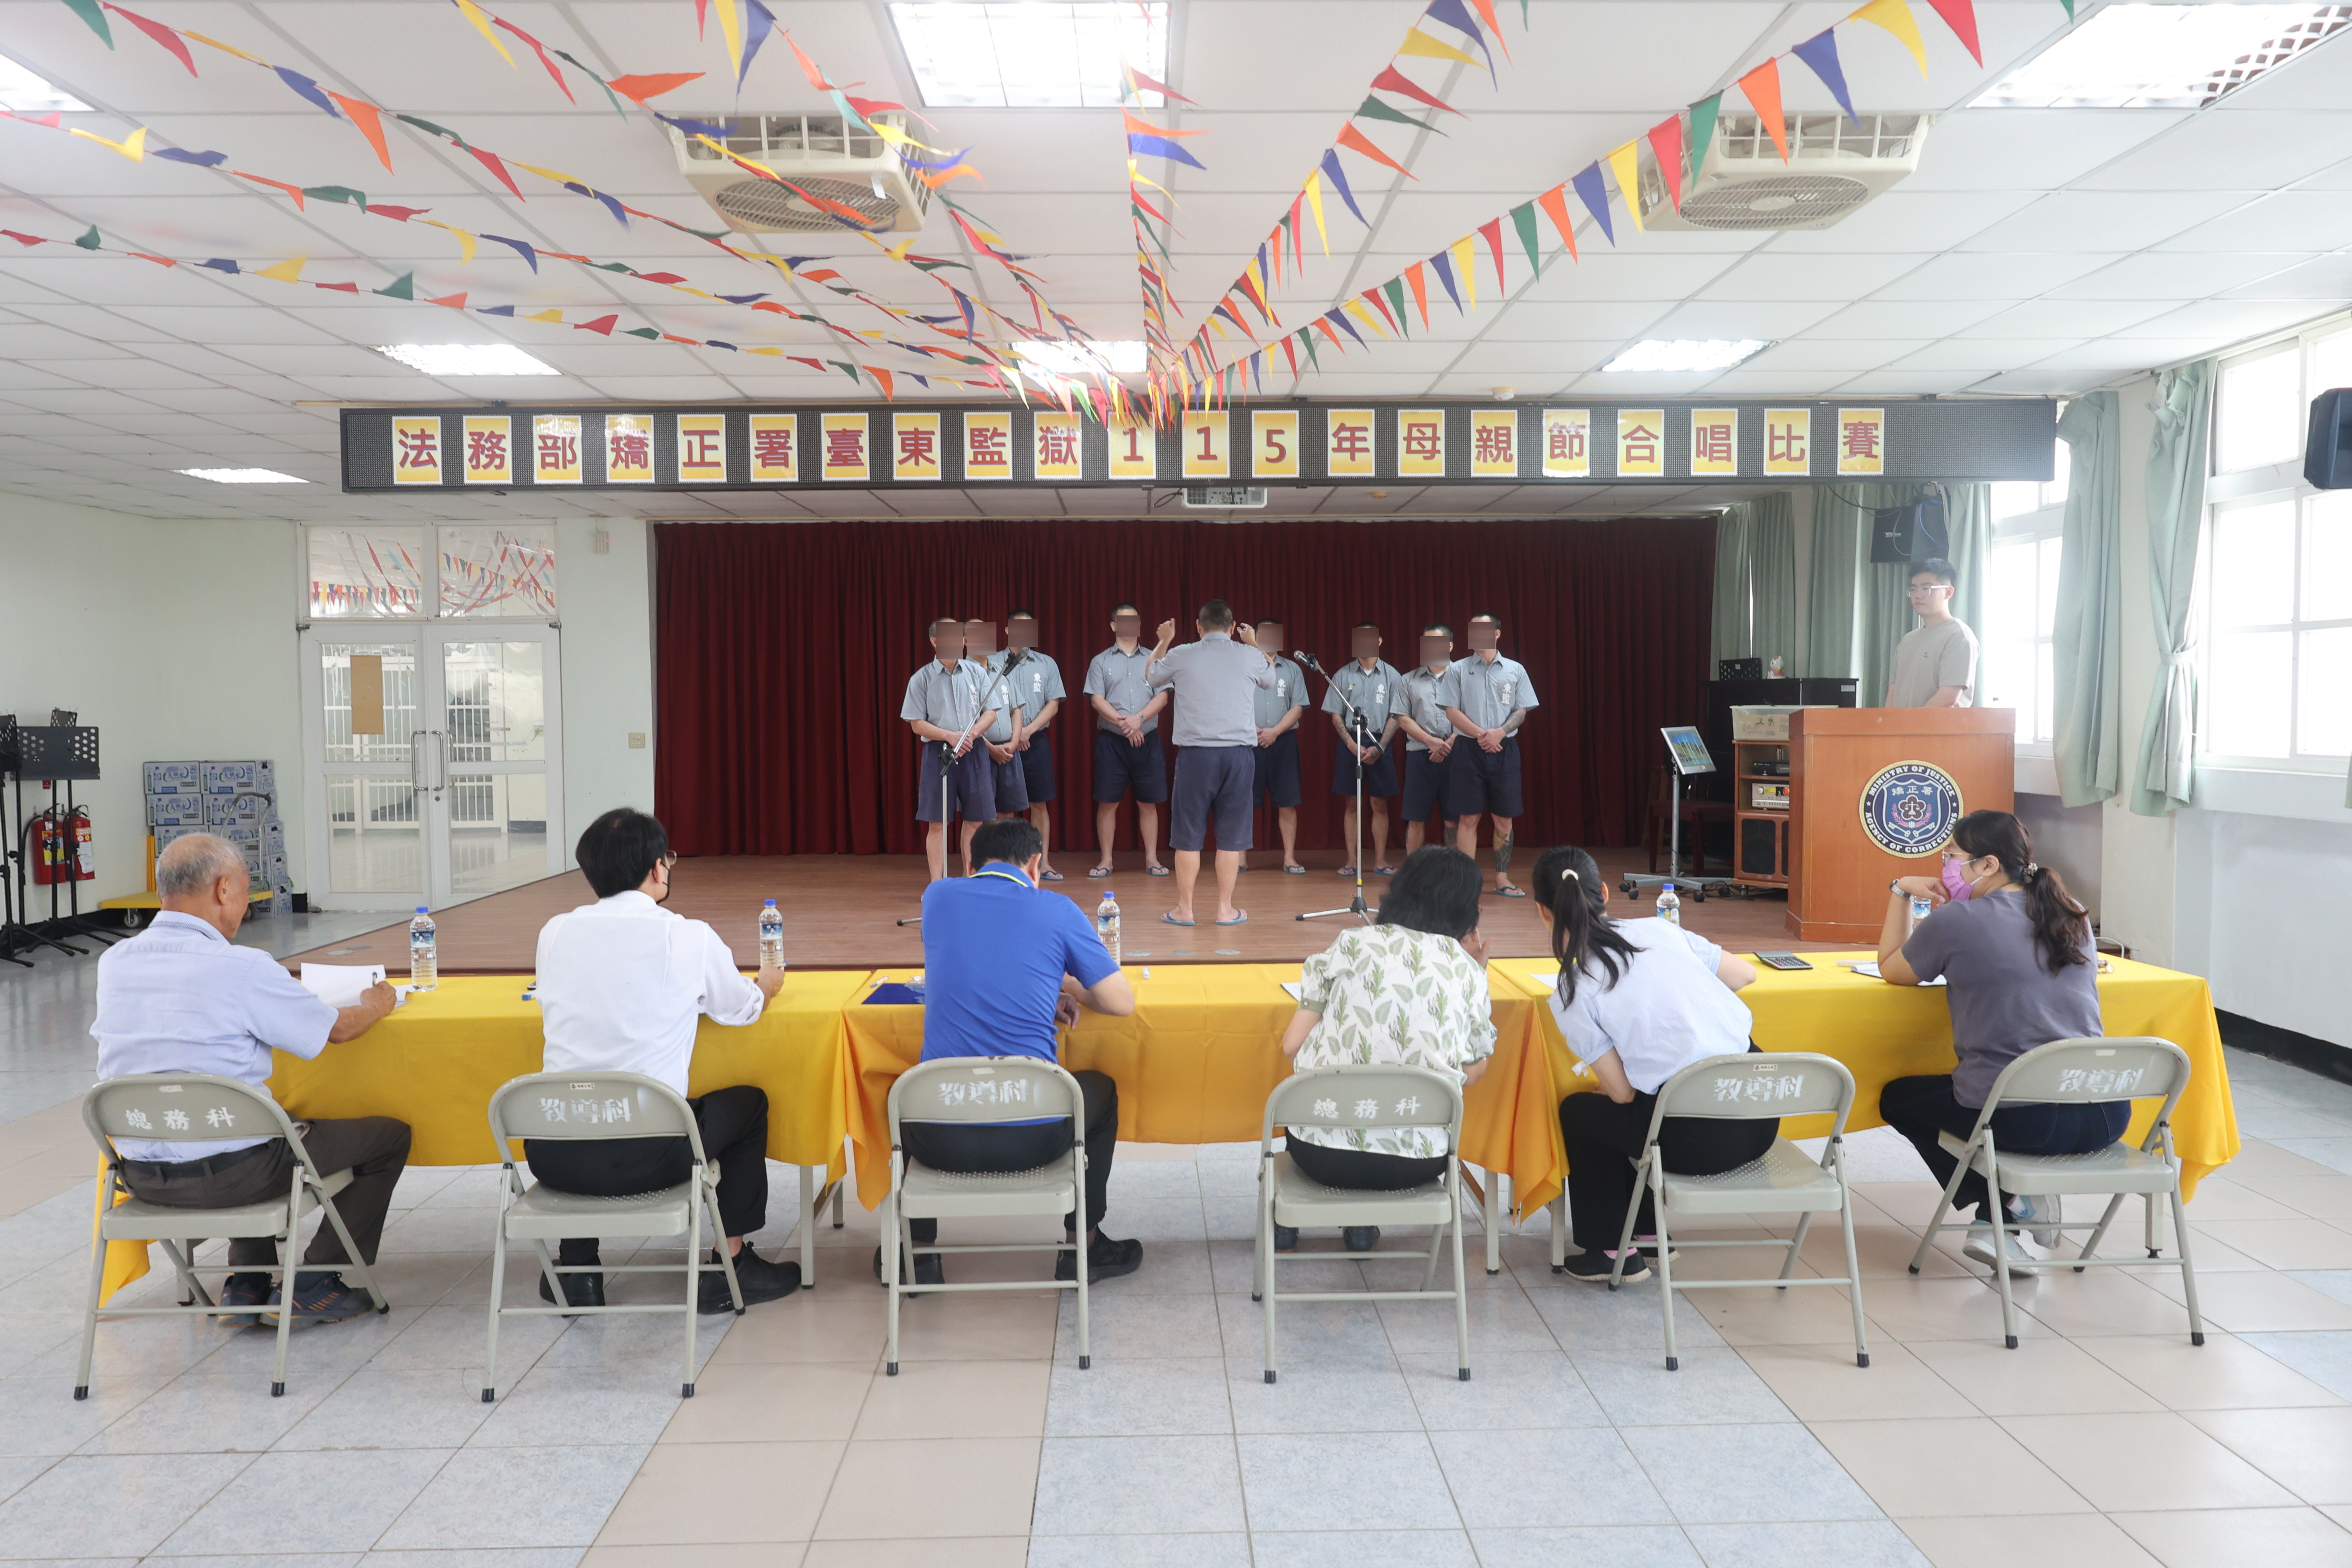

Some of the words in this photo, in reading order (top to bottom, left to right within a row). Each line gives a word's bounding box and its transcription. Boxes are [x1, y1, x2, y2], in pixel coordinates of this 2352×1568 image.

[398, 421, 1880, 470] 法務部矯正署臺東監獄115年母親節合唱比賽
[1869, 766, 1909, 797] MINISTRY
[1926, 767, 1955, 797] JUSTICE
[1891, 785, 1933, 796] 矯正署
[1865, 812, 1889, 844] AGENCY
[1889, 842, 1903, 851] OF
[1905, 812, 1958, 853] CORRECTIONS
[938, 1078, 1029, 1106] 教導科
[1713, 1074, 1804, 1102] 教導科
[125, 1106, 236, 1131] 總務科
[1313, 1096, 1422, 1120] 總務科
